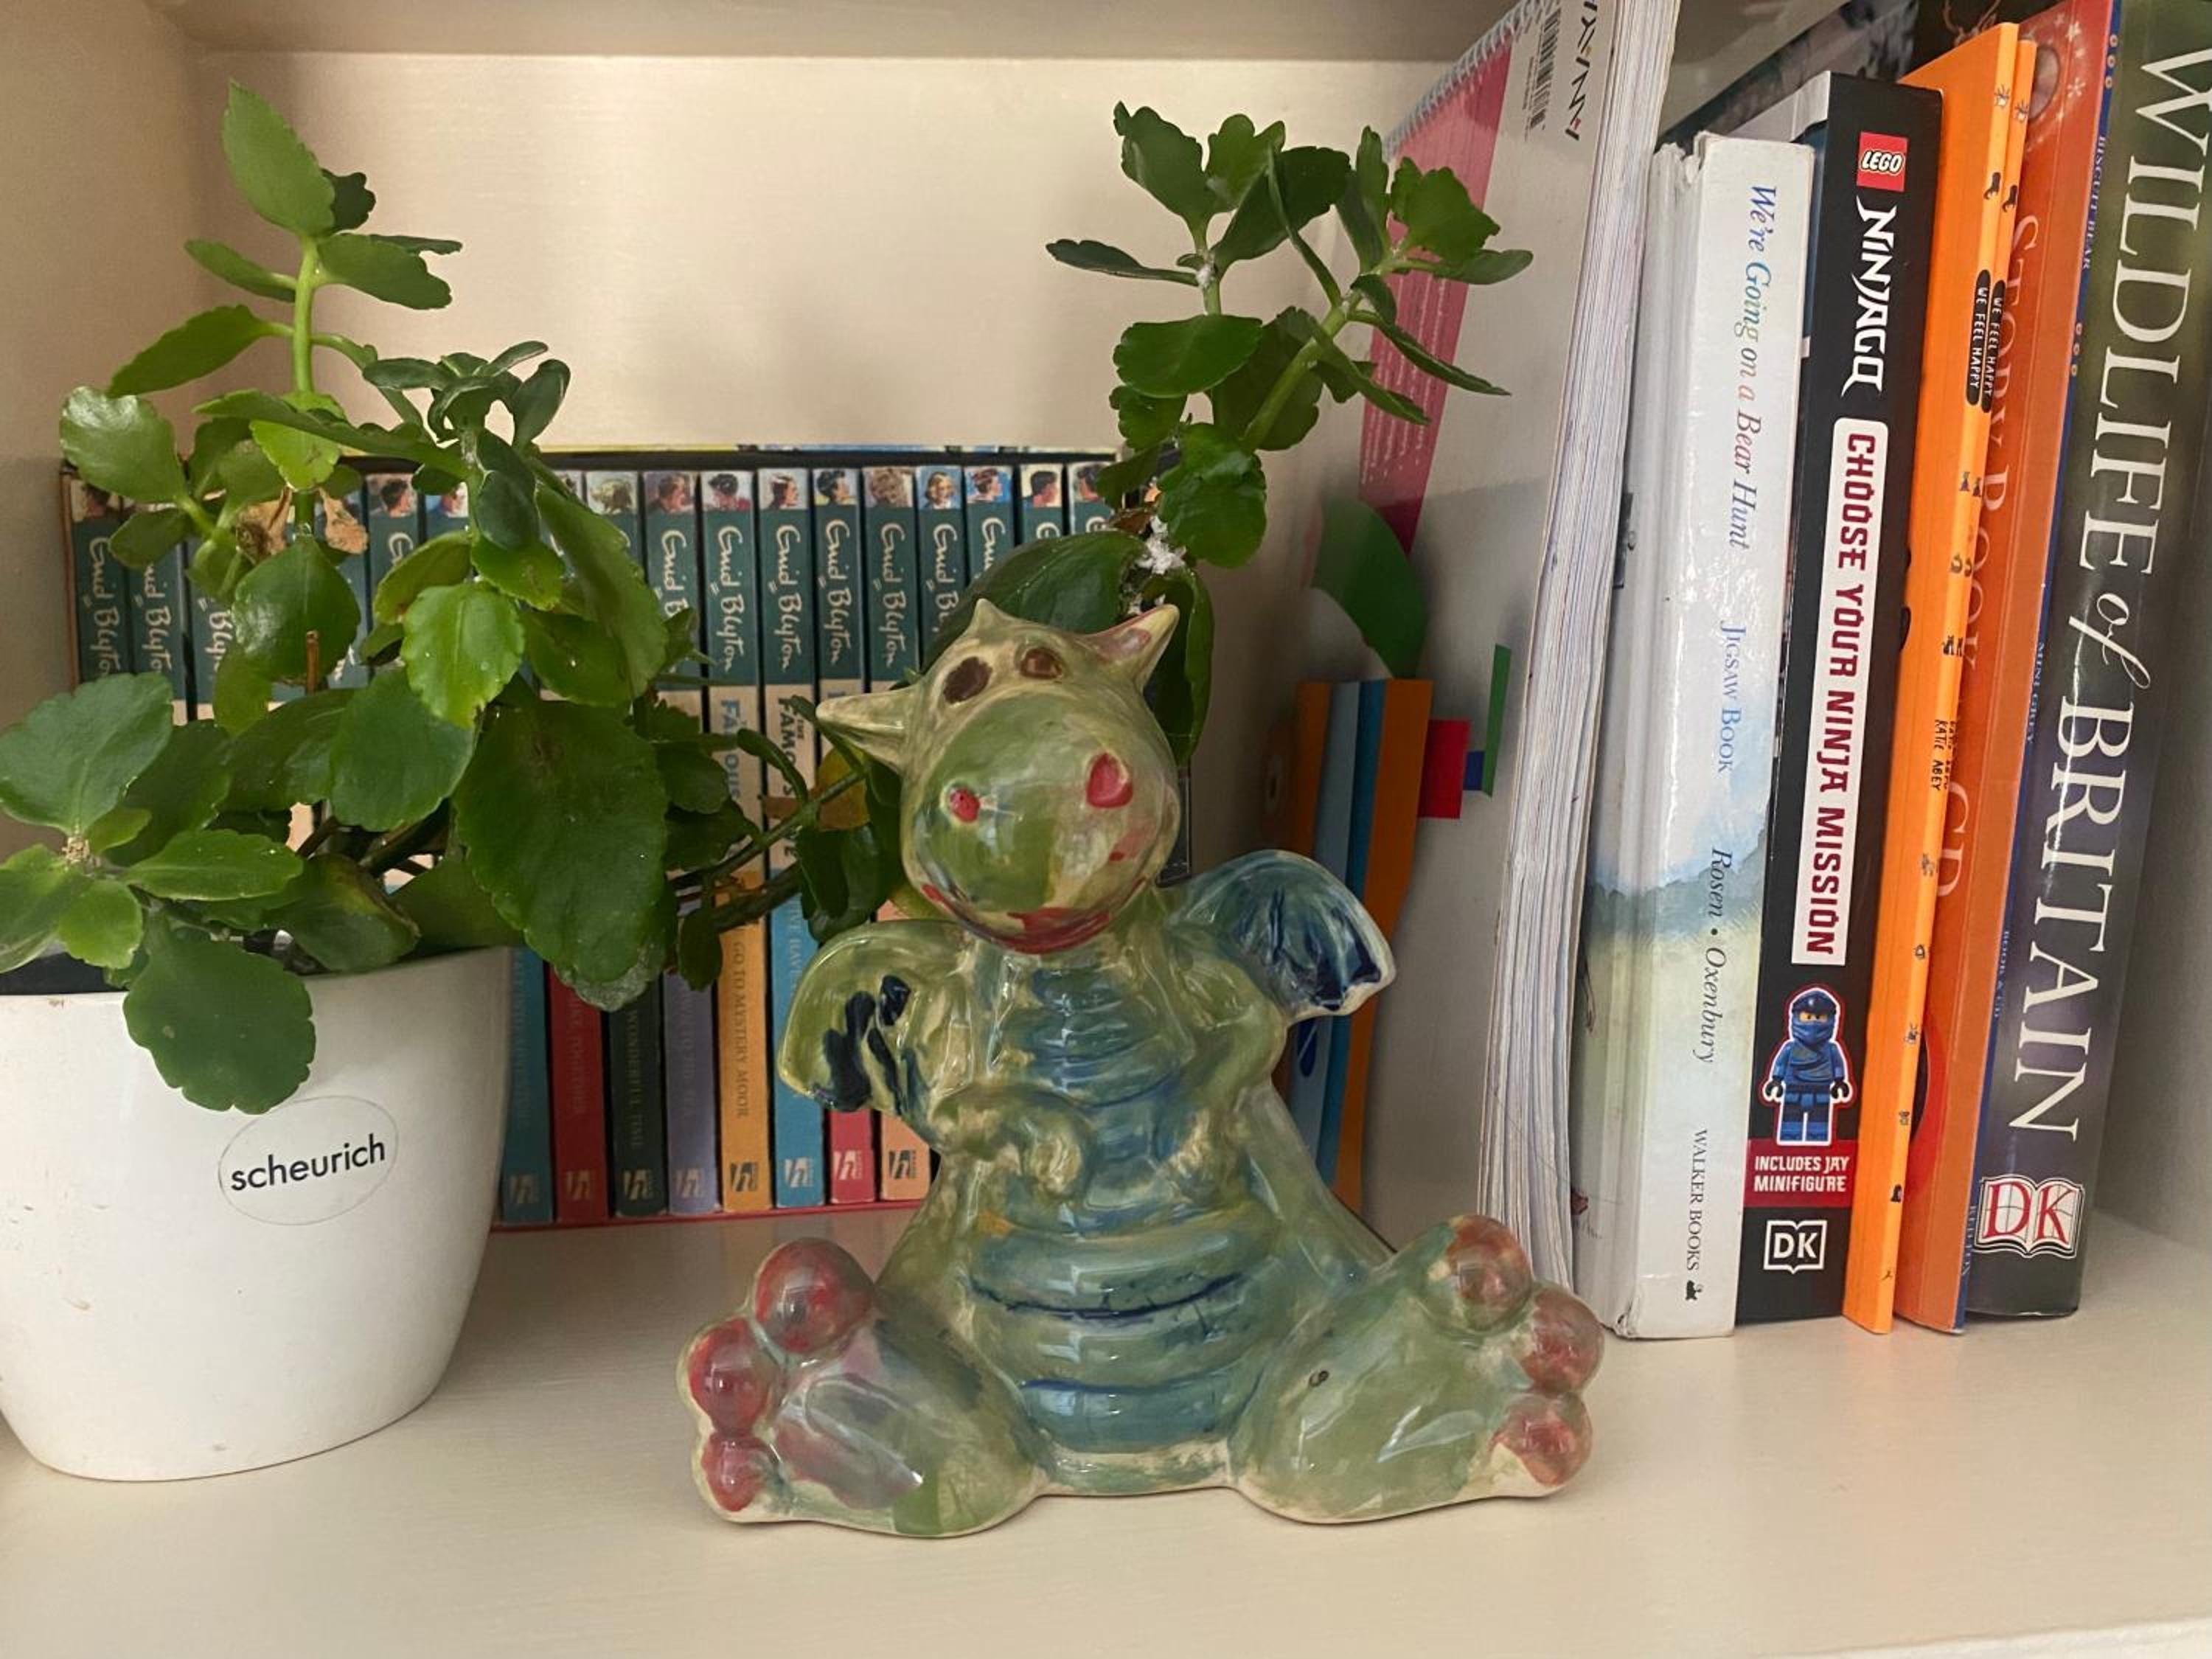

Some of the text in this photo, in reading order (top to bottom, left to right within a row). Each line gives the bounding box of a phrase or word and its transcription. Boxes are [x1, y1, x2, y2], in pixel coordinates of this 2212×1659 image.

[1861, 151, 1904, 173] LEGO
[1840, 195, 1898, 398] NINJAGO
[1969, 287, 1989, 389] WE FEEL HAPPY
[1729, 184, 1777, 549] We're Going on a Bear Hunt
[1983, 297, 2003, 397] WE FEEL HAPPY
[716, 526, 745, 672] Enid Blyton
[774, 525, 801, 669] Enid Blyton
[826, 519, 849, 580] Enid
[879, 523, 906, 667] Enid Blyton
[933, 524, 957, 582] Enid
[2009, 48, 2212, 1141] WILDLIFE of BRITAIN
[90, 606, 120, 676] Blyto
[142, 605, 171, 672] Blyto
[824, 587, 851, 664] Blyton
[1718, 622, 1746, 773] JIGSAW BOOK
[1806, 434, 1876, 954] CHOOSE YOUR NINJA MISSION
[779, 698, 796, 796] FAMOS
[1930, 719, 1948, 791] KATIE ABEY
[1693, 848, 1733, 1063] Rosen Oxenbury
[733, 941, 749, 1119] GO TO MYSTERY MOOR
[231, 1133, 386, 1192] scheurich
[1686, 1129, 1708, 1270] WALKER BOOKS
[1753, 1175, 1847, 1192] MINIFIGURE
[1754, 1155, 1849, 1174] INCLUDES JAY
[1773, 1232, 1818, 1259] DK
[1984, 1180, 2075, 1245] DK
